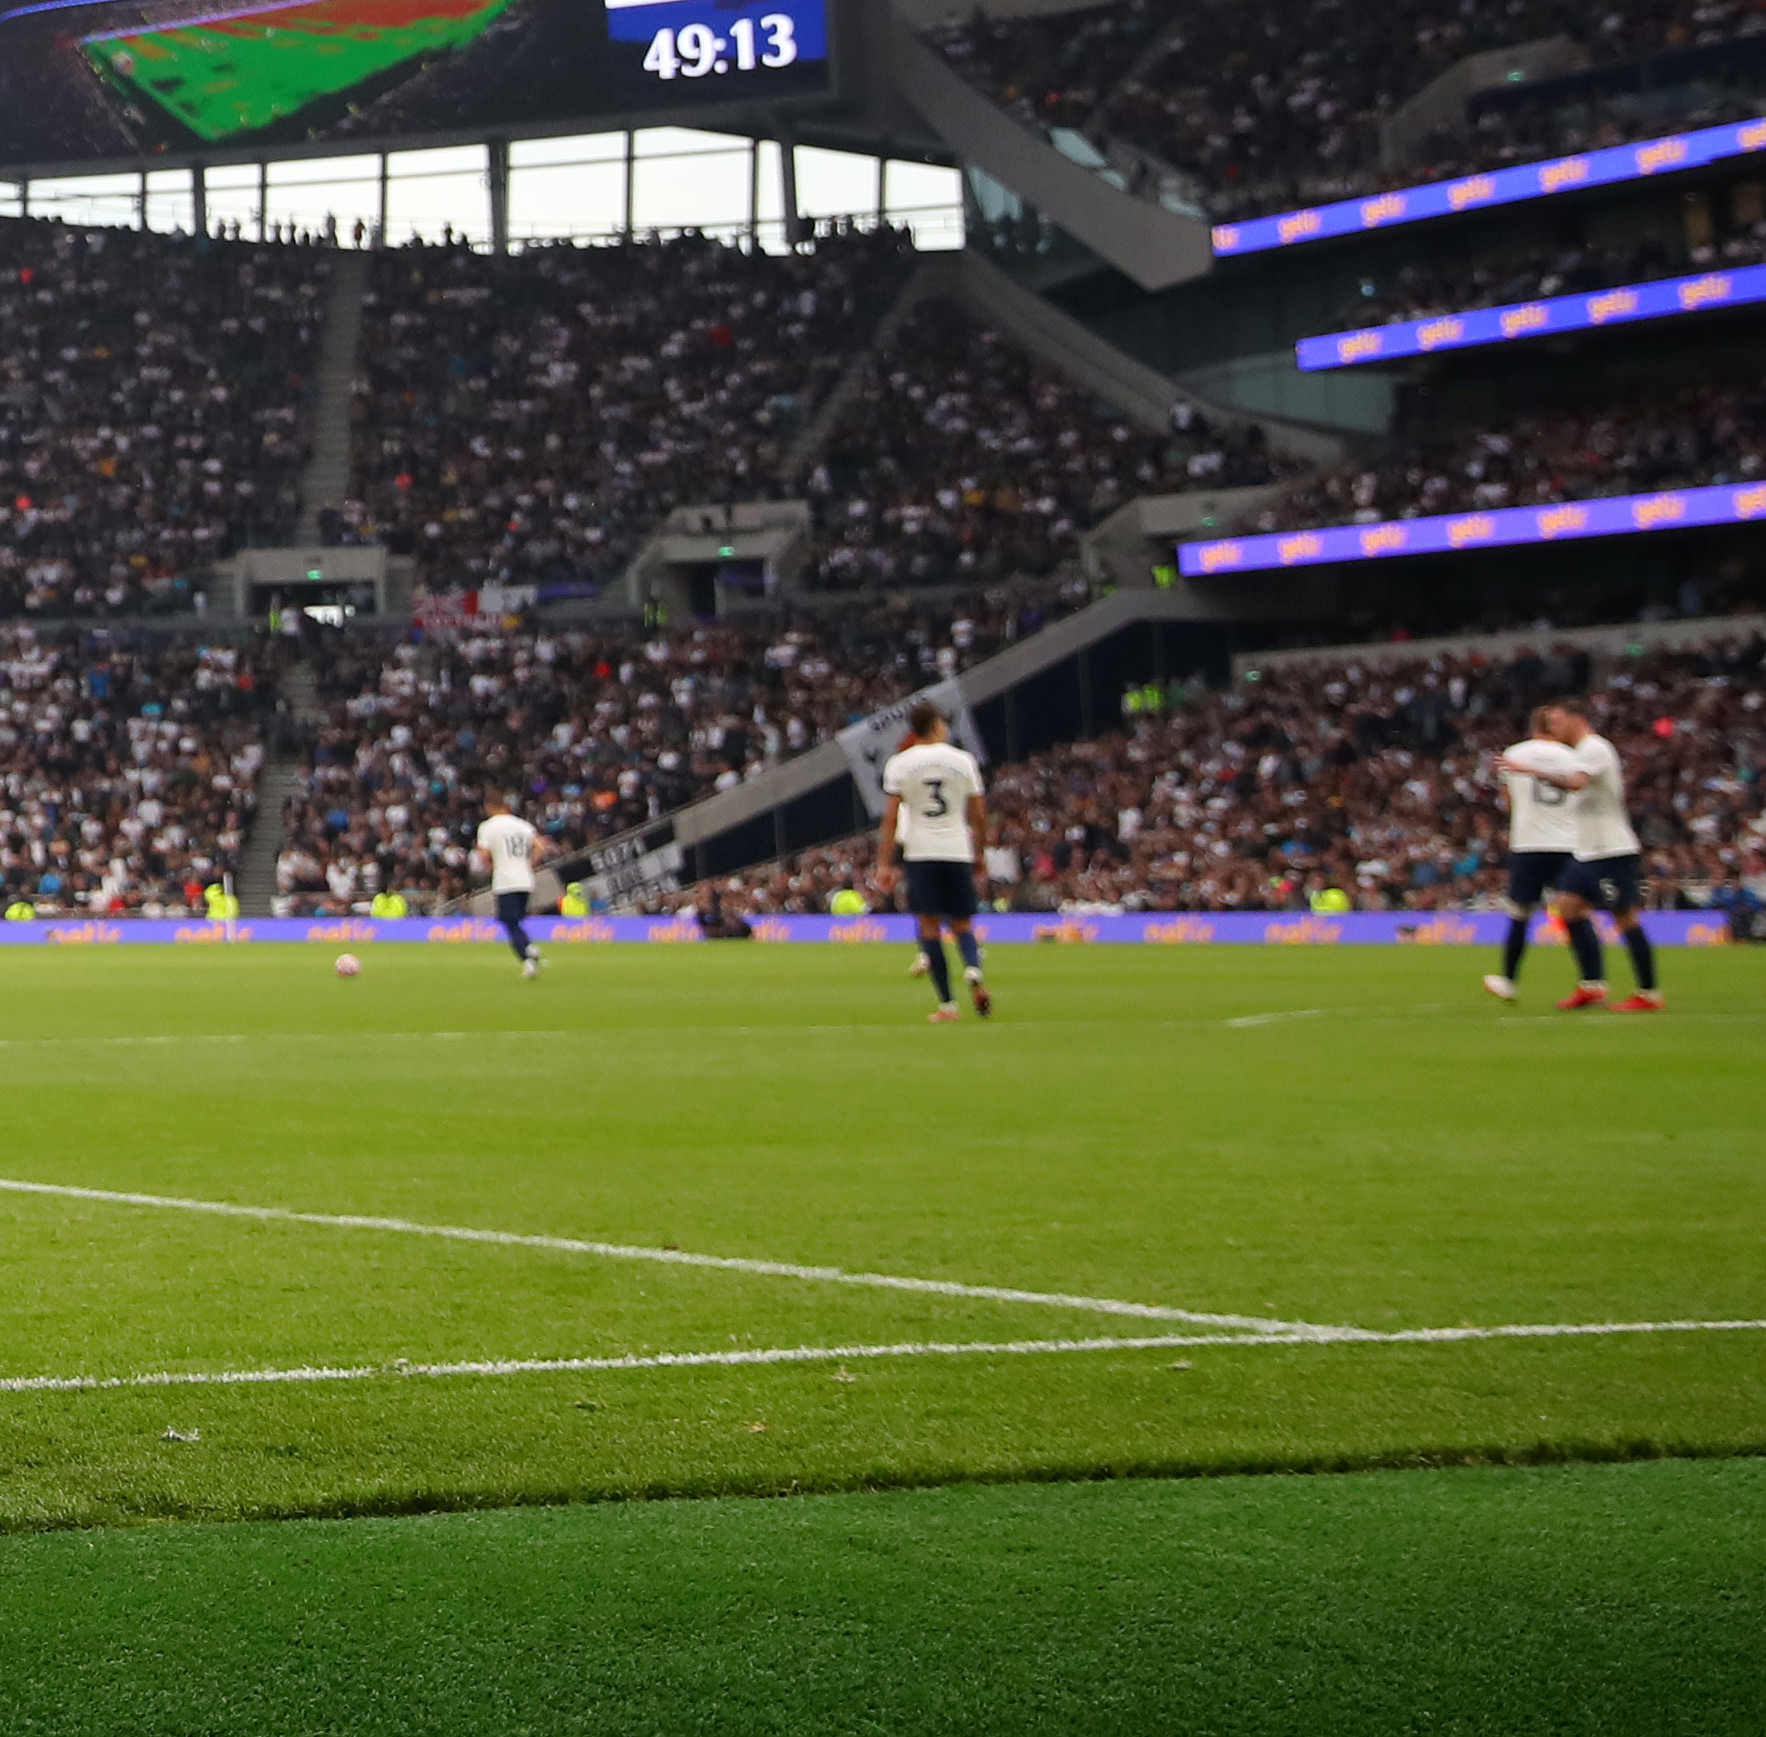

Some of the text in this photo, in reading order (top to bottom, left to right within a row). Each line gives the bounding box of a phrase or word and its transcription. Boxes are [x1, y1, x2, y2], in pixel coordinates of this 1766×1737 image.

[642, 12, 798, 81] 49:13
[924, 778, 946, 817] 3
[175, 921, 253, 943] etr
